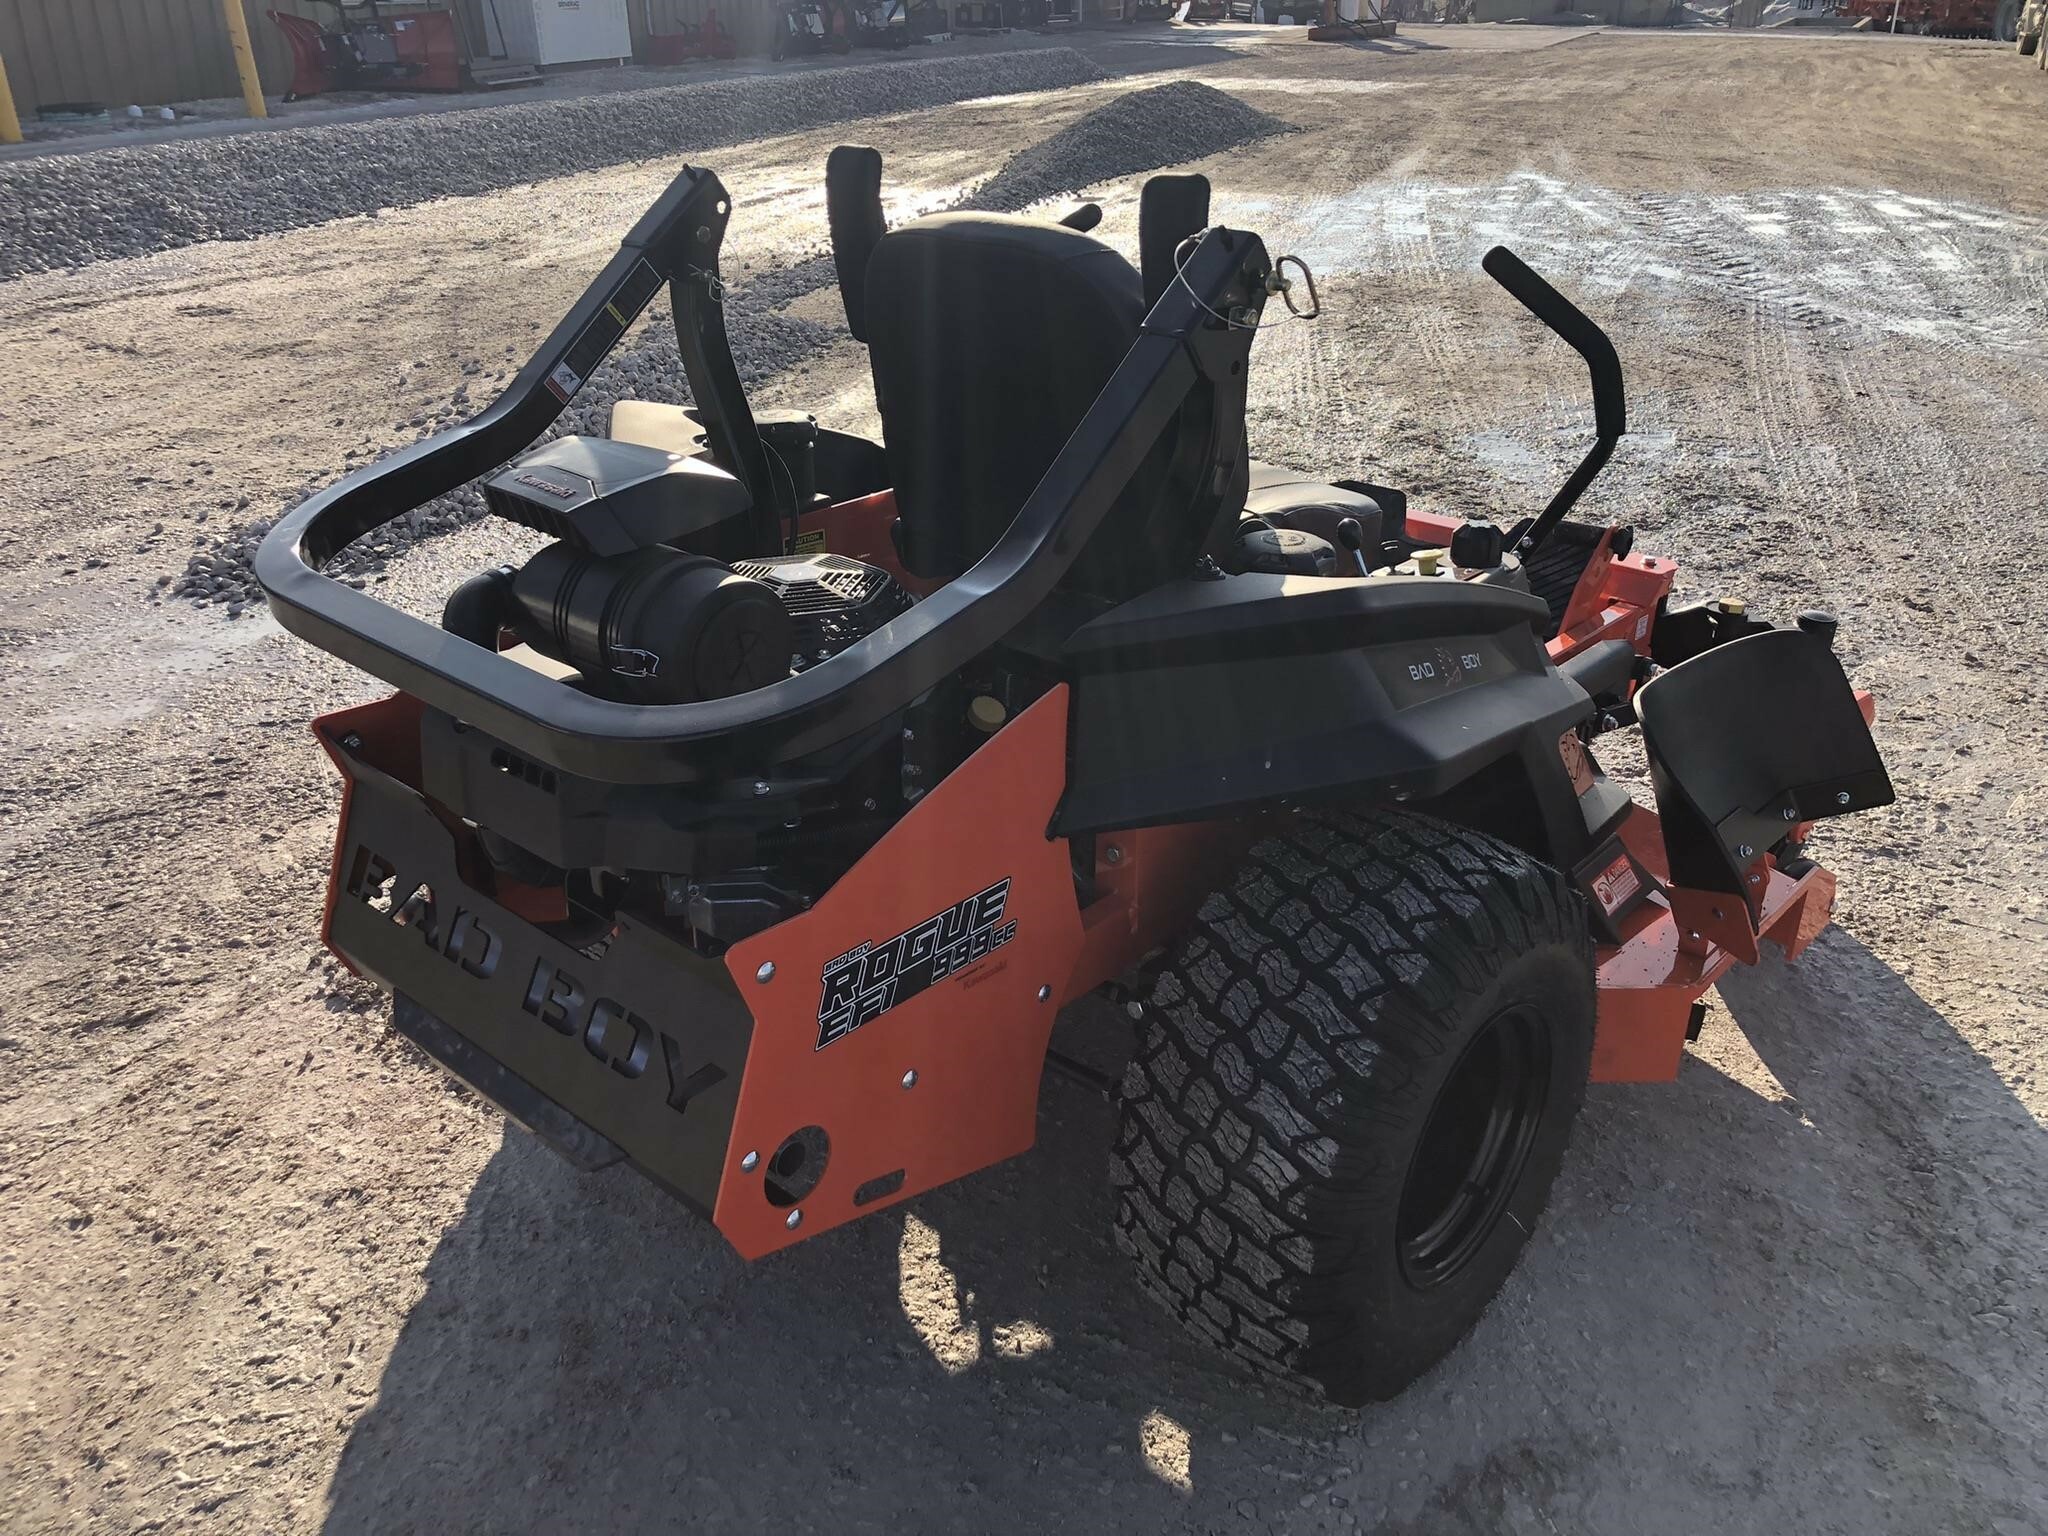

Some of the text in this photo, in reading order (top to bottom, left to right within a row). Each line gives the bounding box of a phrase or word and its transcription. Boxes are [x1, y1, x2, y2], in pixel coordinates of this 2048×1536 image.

[514, 474, 577, 499] Kawasaki
[1408, 653, 1482, 681] BAD BOY
[818, 877, 1011, 1019] ROGUE
[824, 940, 872, 974] BAD BOY
[346, 843, 728, 1114] BAD BOY
[815, 977, 899, 1051] EFI
